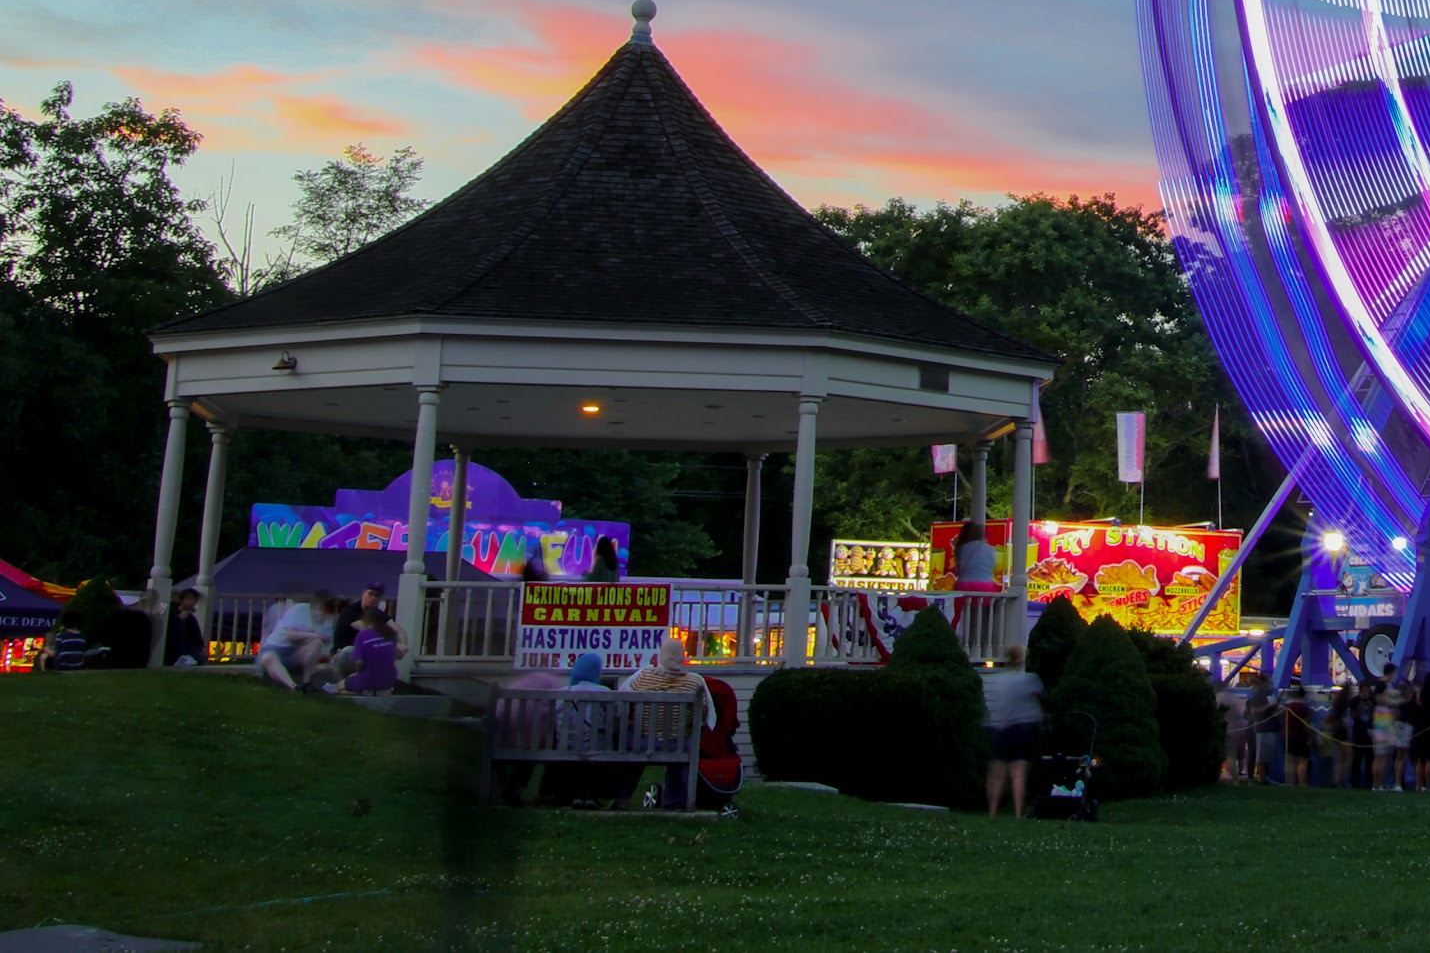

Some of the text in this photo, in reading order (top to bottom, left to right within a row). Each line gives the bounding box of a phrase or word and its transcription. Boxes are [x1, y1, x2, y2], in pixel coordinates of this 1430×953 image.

[540, 530, 618, 575] FU
[1049, 526, 1206, 563] FRY STATION
[525, 586, 667, 606] LEXINGTON LIONS CLUB
[1025, 583, 1050, 591] RENCH
[1098, 585, 1125, 593] CHICKEN
[1166, 586, 1198, 594] MOZZARELLA
[1106, 589, 1149, 607] ENDERS
[1180, 593, 1209, 614] STIC
[533, 607, 658, 622] CARNIVAL
[522, 628, 664, 650] HASTINGS PARK
[521, 652, 561, 668] JUNE
[605, 653, 643, 668] JULY
